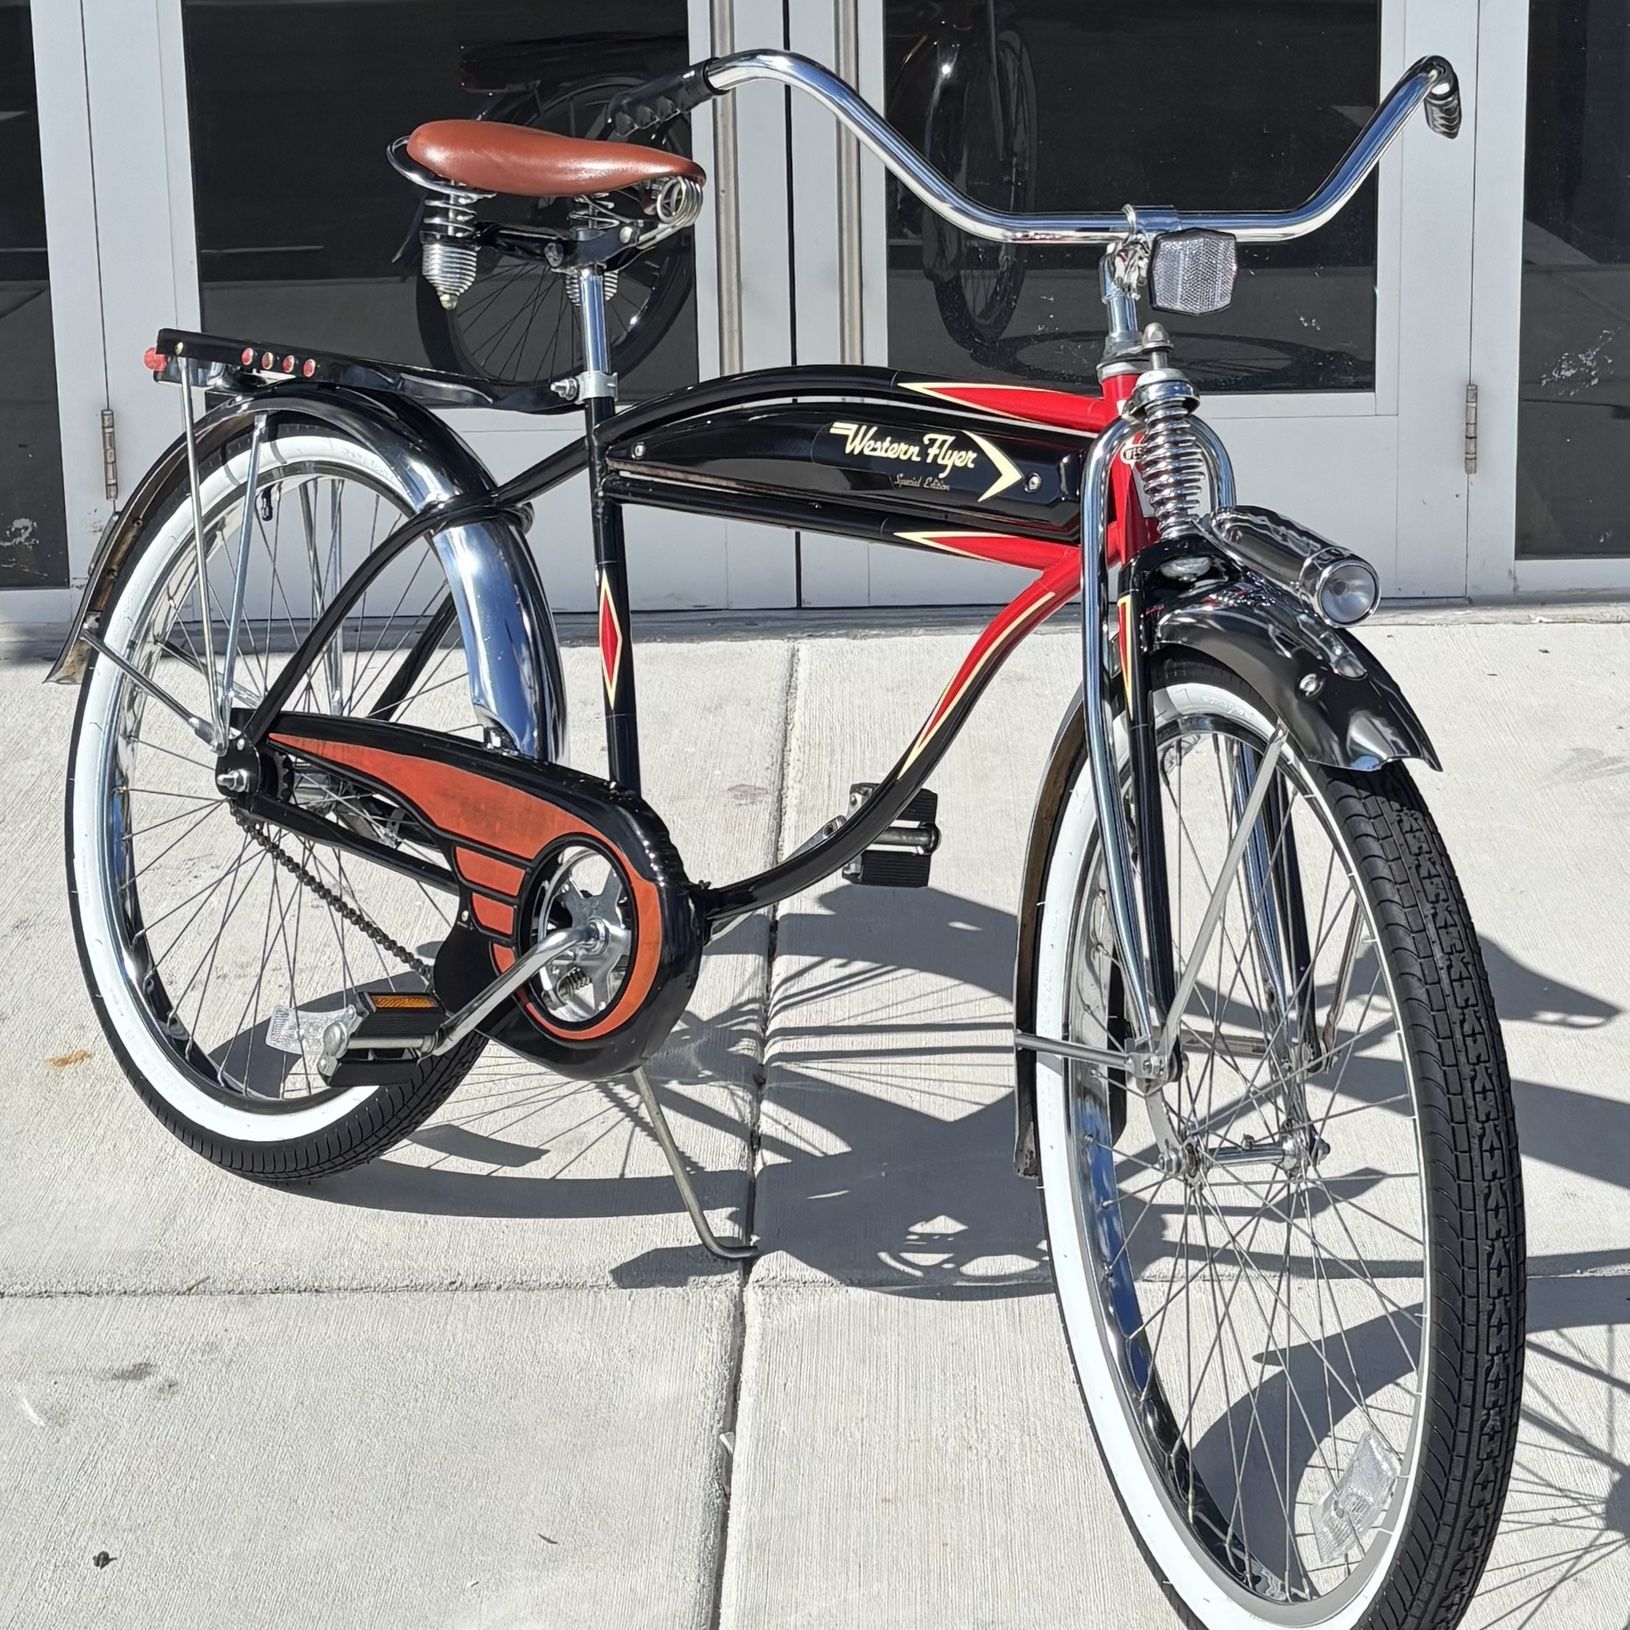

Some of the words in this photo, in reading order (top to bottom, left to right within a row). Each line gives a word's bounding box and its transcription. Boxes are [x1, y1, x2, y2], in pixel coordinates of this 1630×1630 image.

[830, 422, 921, 462] Western
[923, 433, 978, 479] Flyer
[894, 473, 923, 488] Special
[923, 476, 950, 491] Edition
